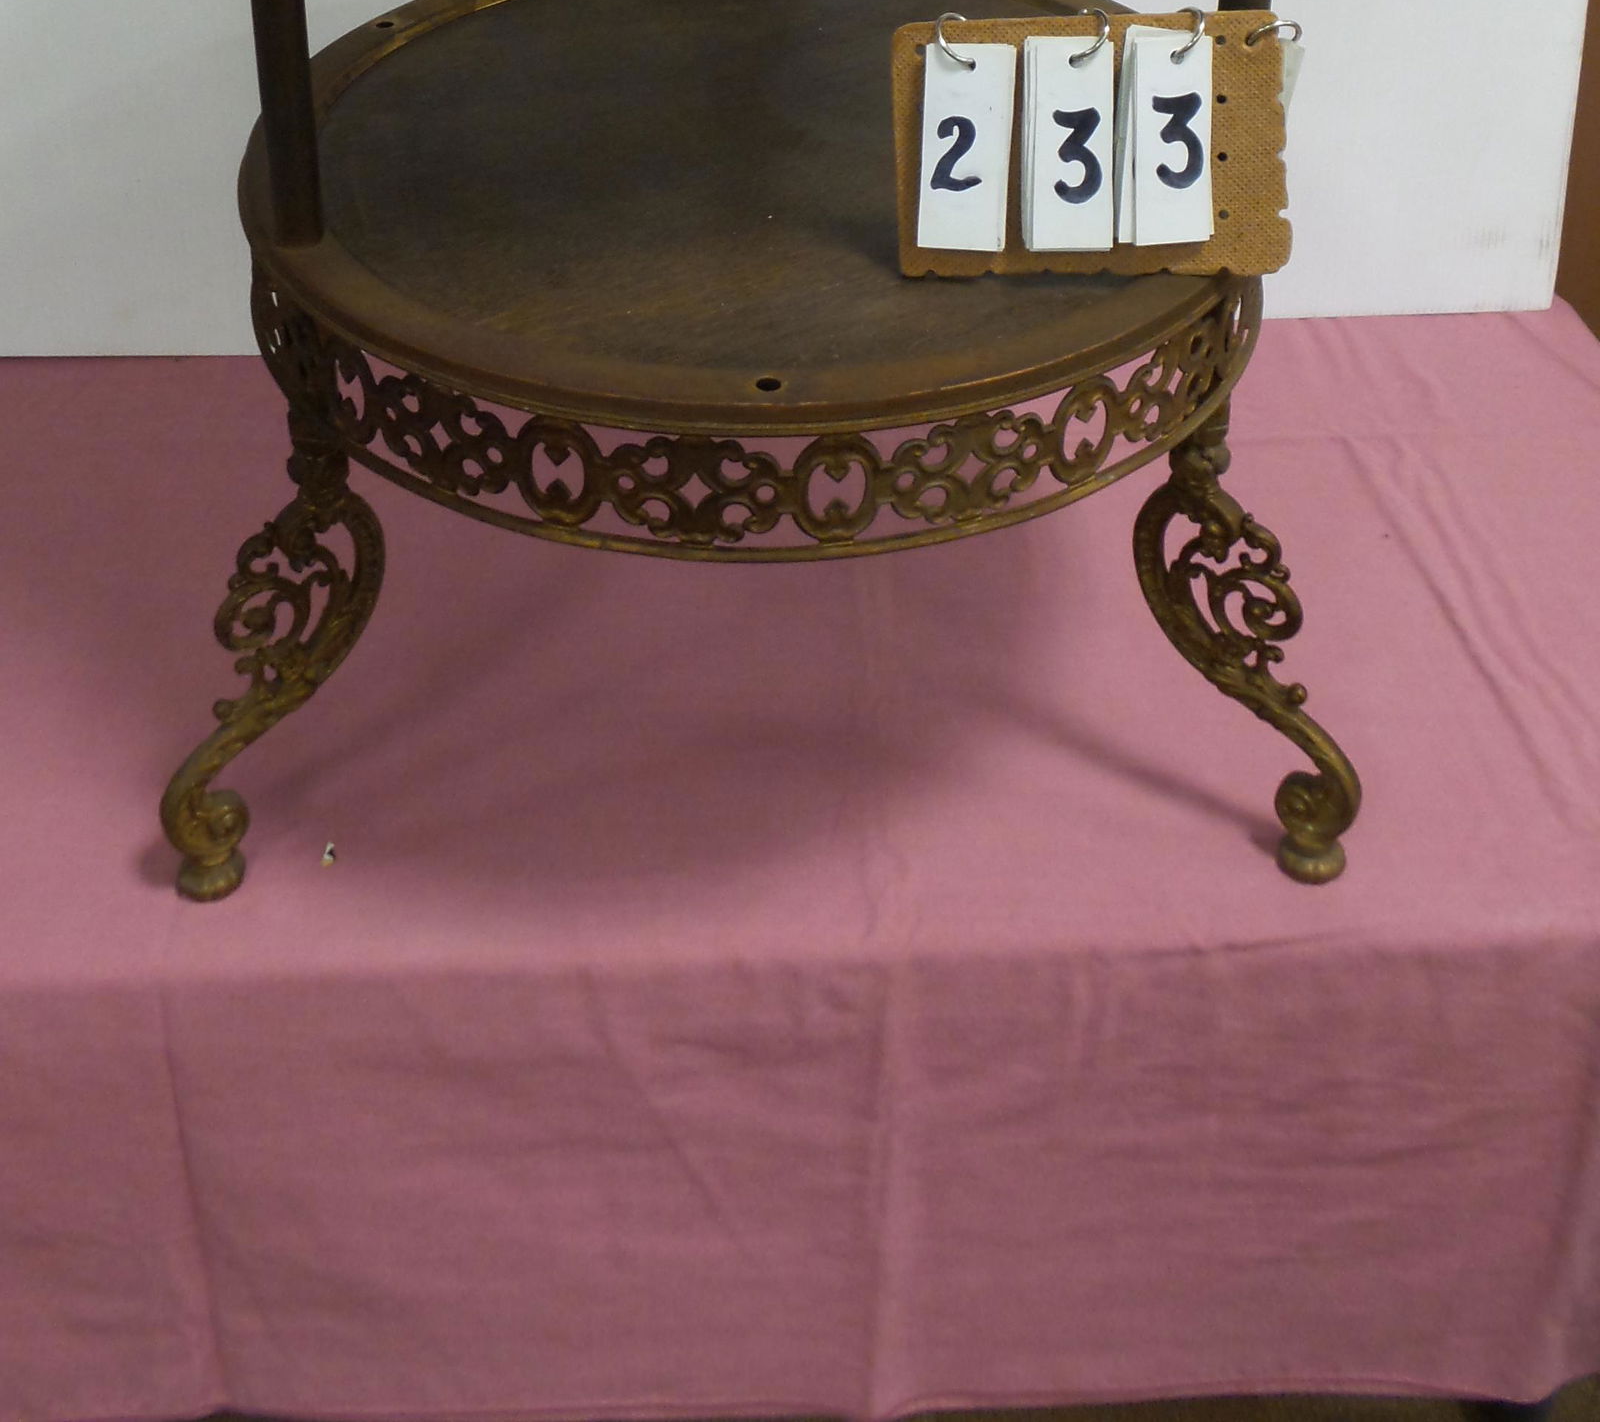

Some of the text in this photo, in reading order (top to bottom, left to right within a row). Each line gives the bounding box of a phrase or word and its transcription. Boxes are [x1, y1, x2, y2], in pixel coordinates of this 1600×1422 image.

[930, 92, 1204, 204] 2 3 3
